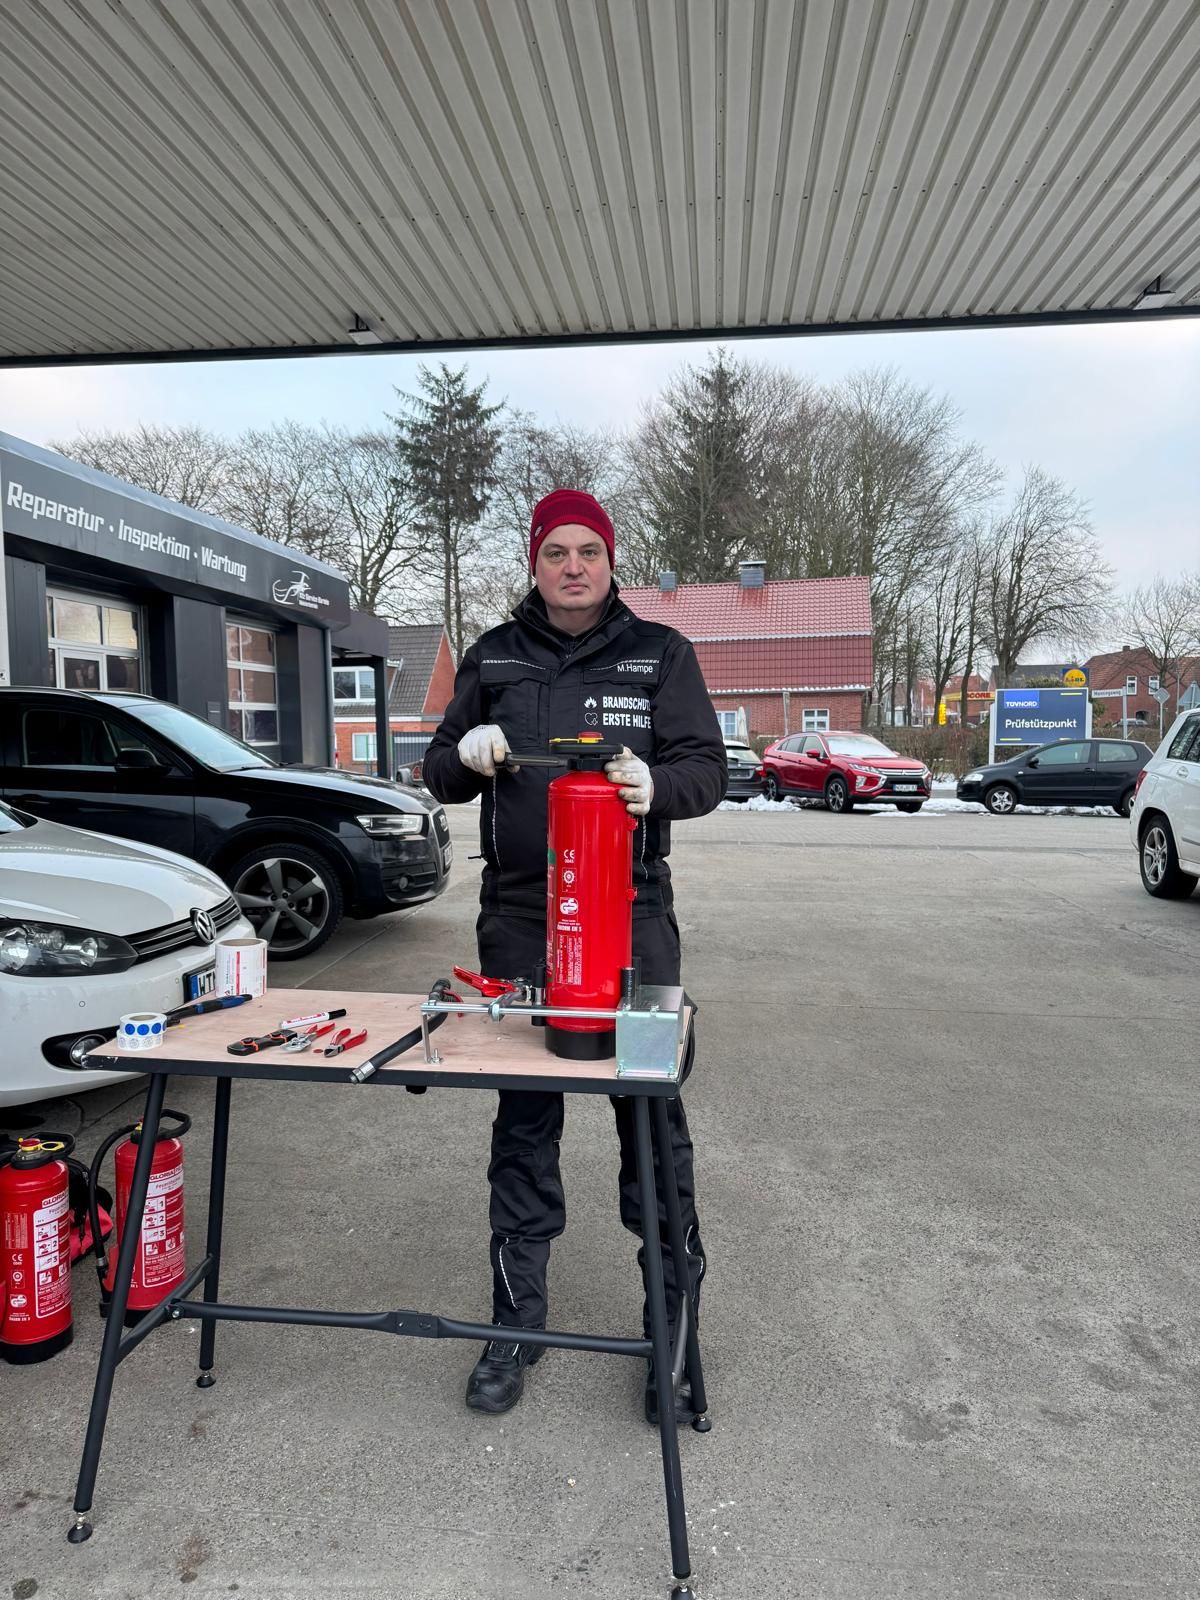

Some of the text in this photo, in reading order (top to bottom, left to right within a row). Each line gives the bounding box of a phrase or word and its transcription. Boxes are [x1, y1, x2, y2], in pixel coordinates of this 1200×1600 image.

[7, 481, 247, 582] Reparatur Inspektion Wartung
[617, 664, 653, 675] M.Hampe
[602, 713, 652, 729] ERSTE HILFE
[1005, 718, 1078, 730] Prüfstützpunkt
